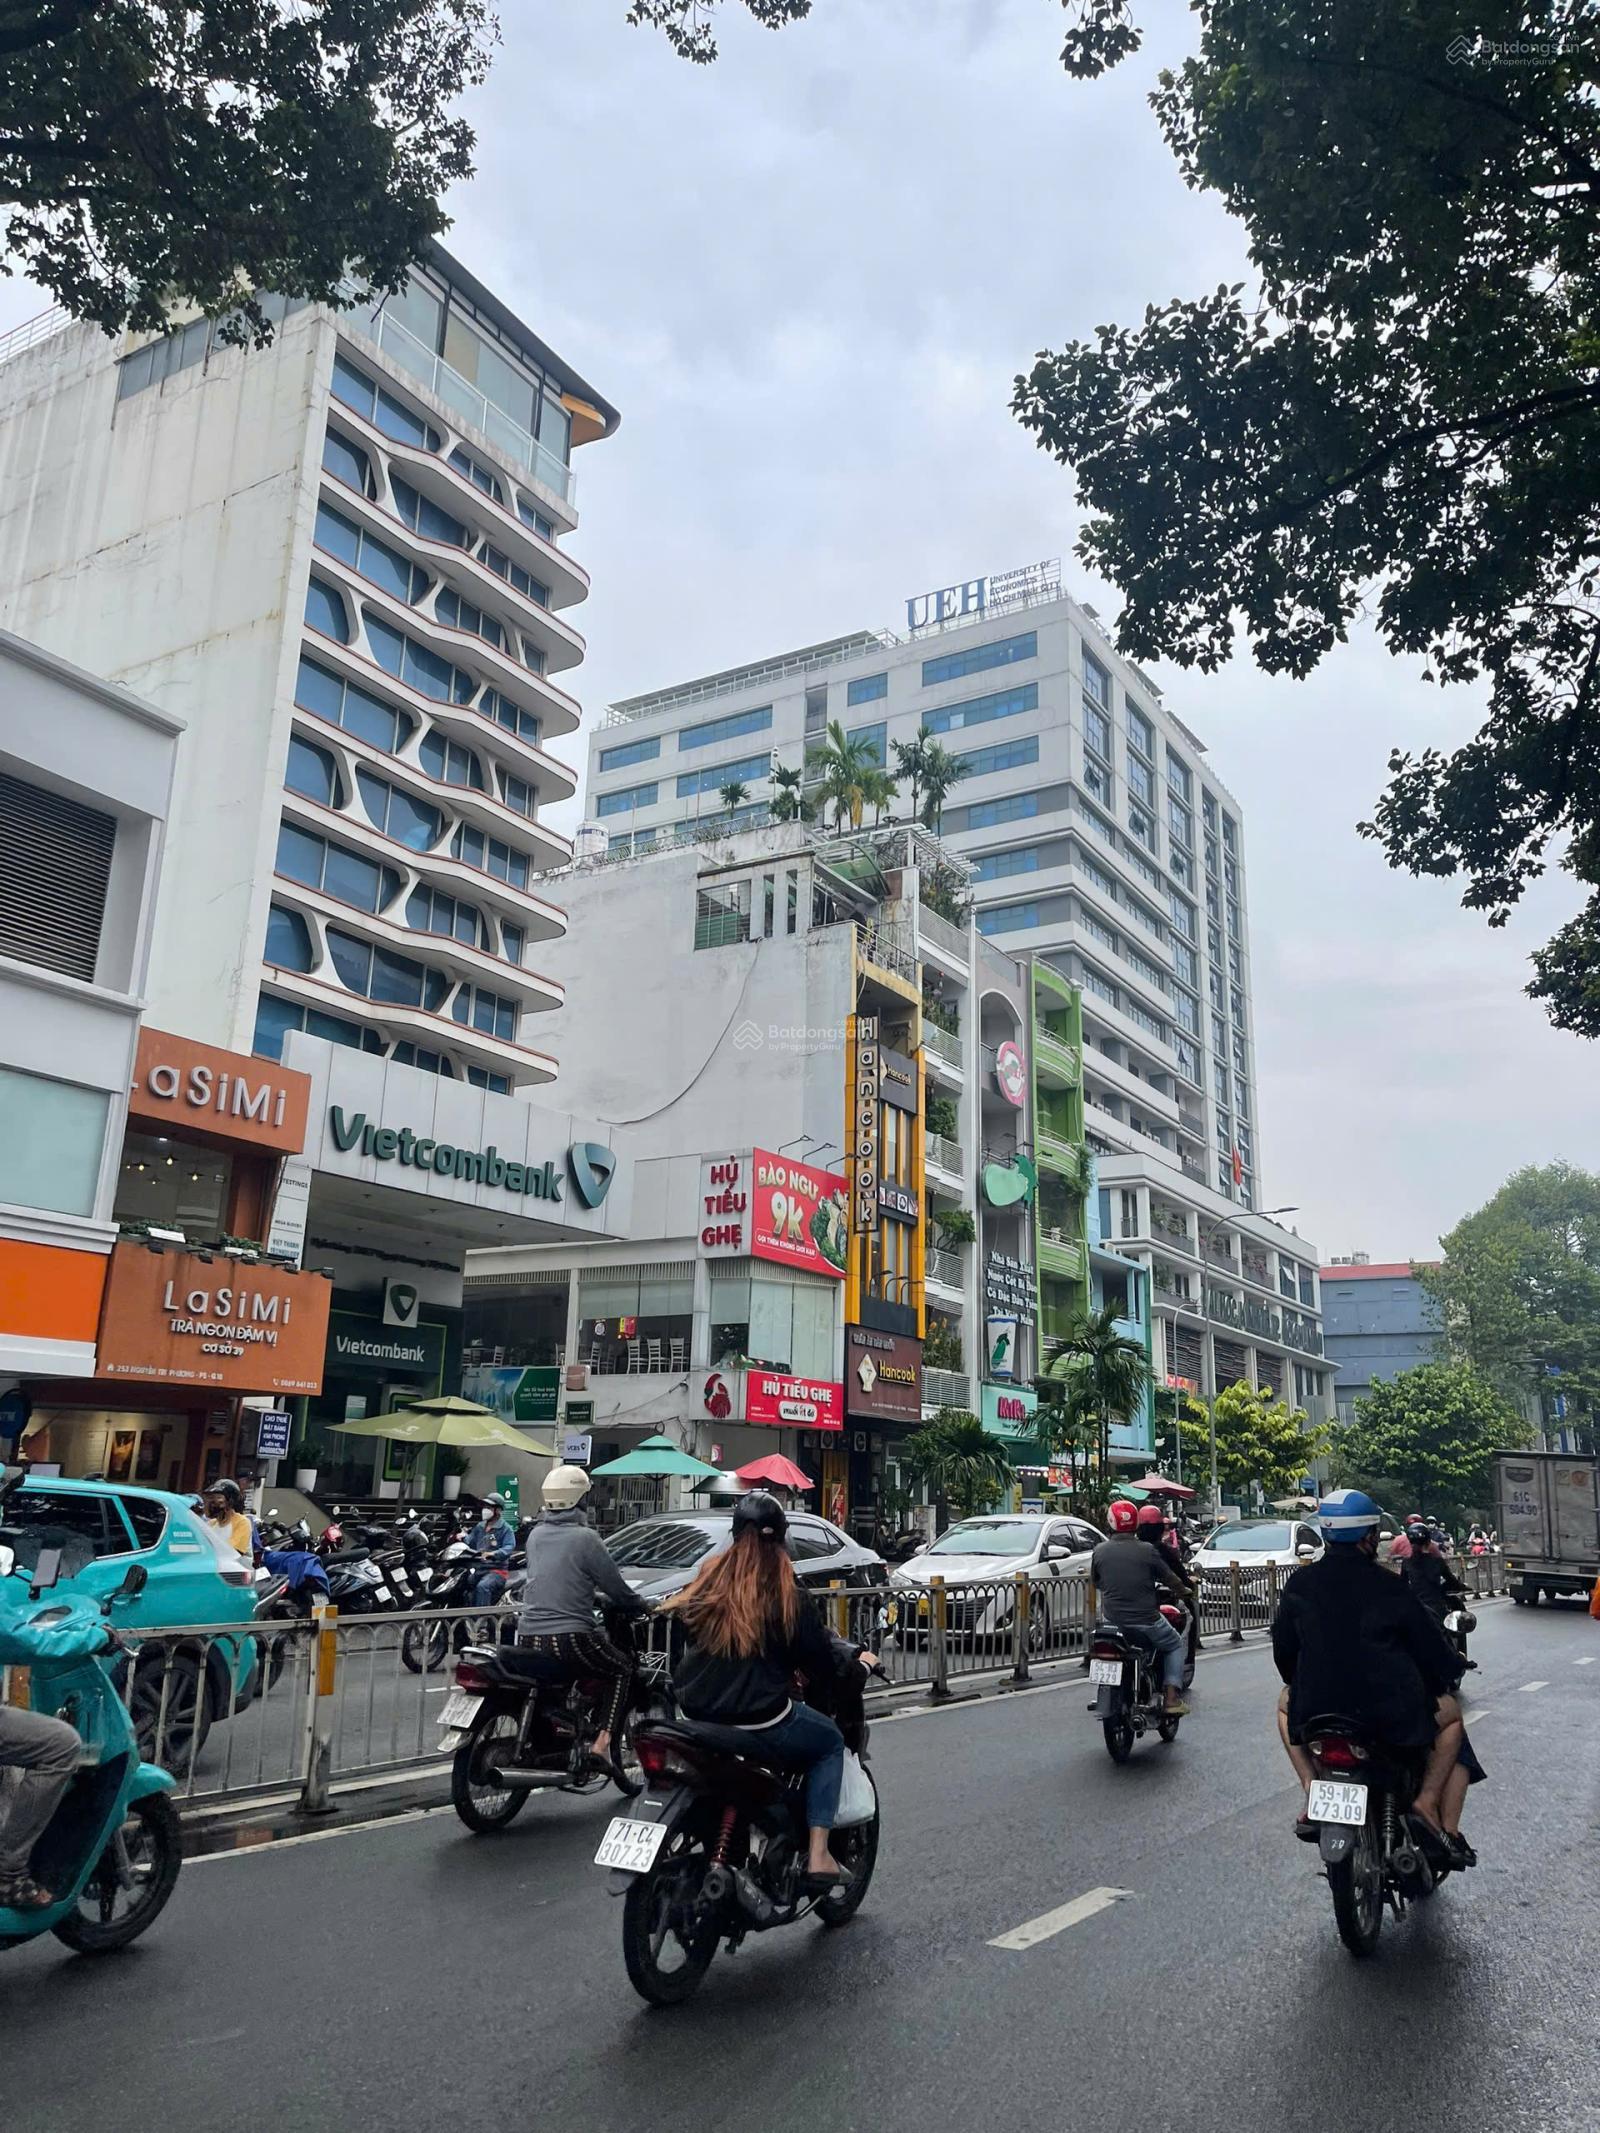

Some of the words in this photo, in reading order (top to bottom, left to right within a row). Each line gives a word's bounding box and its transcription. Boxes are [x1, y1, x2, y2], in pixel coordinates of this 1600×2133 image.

[990, 564, 1038, 585] UNIVERSITY
[990, 577, 1037, 596] ECONOMICS
[905, 577, 987, 631] UEH
[130, 1064, 286, 1127] aSiMi
[331, 1105, 565, 1201] Vietcombank
[710, 1155, 739, 1184] HỦ
[758, 1161, 786, 1187] BÀO
[789, 1170, 819, 1201] NGƯ
[704, 1183, 747, 1215] TIẾU
[701, 1224, 742, 1250] GHẸ
[164, 1280, 291, 1325] LaSiMi
[171, 1317, 194, 1334] TRÀ
[196, 1321, 235, 1339] NGON
[236, 1325, 264, 1343] ĐẬM
[265, 1330, 278, 1347] VỊ
[202, 1343, 218, 1353] CƠ
[218, 1340, 232, 1354] SỞ
[336, 1335, 425, 1362] Vietcombank
[879, 1360, 915, 1382] Hancook
[762, 1376, 780, 1396] HỦ
[781, 1379, 808, 1400] TIẾU
[810, 1387, 832, 1407] GHẸ
[1312, 1801, 1362, 1821] 473.09
[600, 1842, 653, 1867] 307.23
